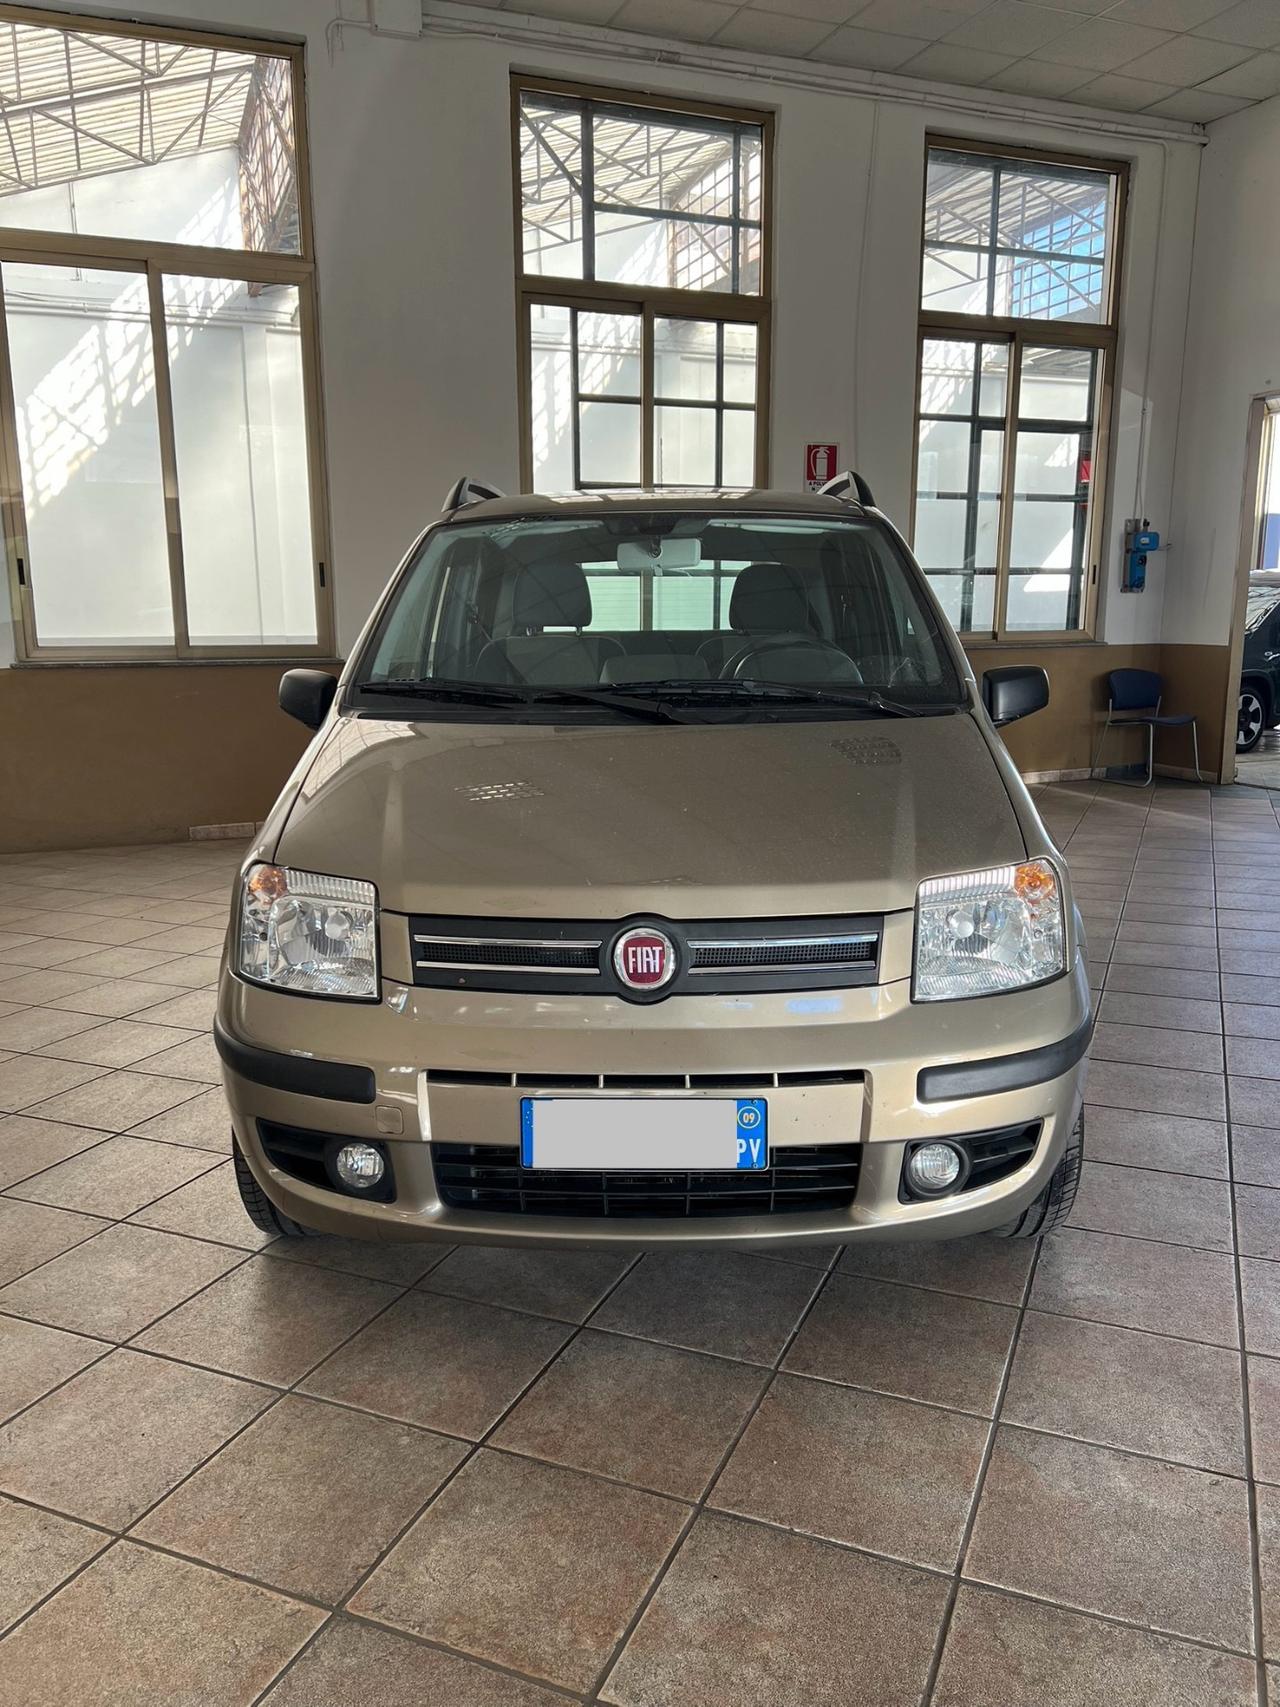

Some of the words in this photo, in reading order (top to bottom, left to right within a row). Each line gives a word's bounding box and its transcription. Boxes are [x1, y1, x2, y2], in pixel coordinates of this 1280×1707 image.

[628, 946, 663, 974] FIAT
[743, 1112, 755, 1124] 09
[736, 1138, 761, 1164] PV
